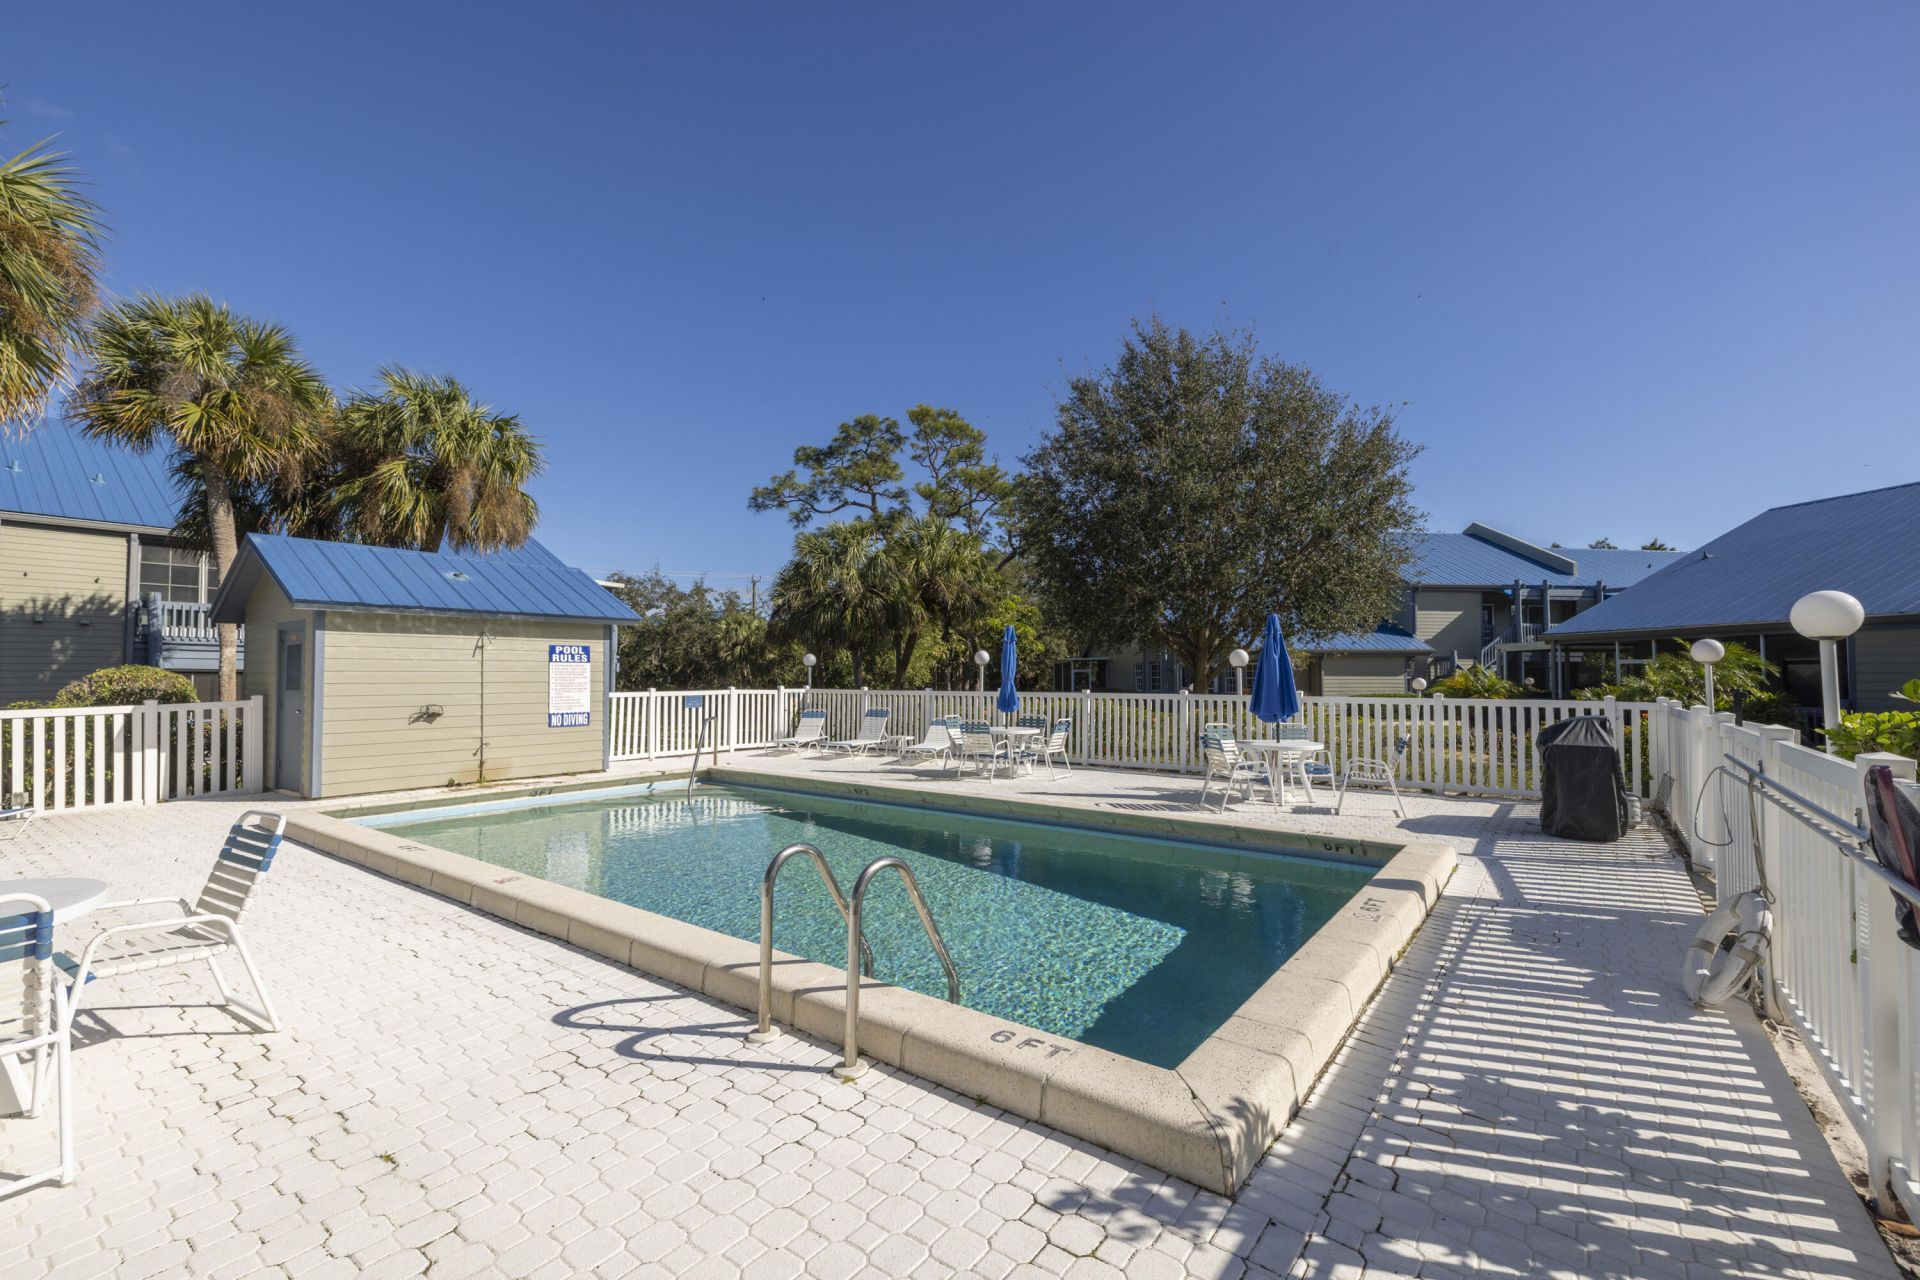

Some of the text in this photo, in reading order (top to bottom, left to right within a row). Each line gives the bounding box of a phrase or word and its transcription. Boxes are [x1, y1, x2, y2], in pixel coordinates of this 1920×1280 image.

[555, 646, 585, 654] POOL
[552, 654, 588, 662] RULES
[551, 713, 588, 727] NO DIVING
